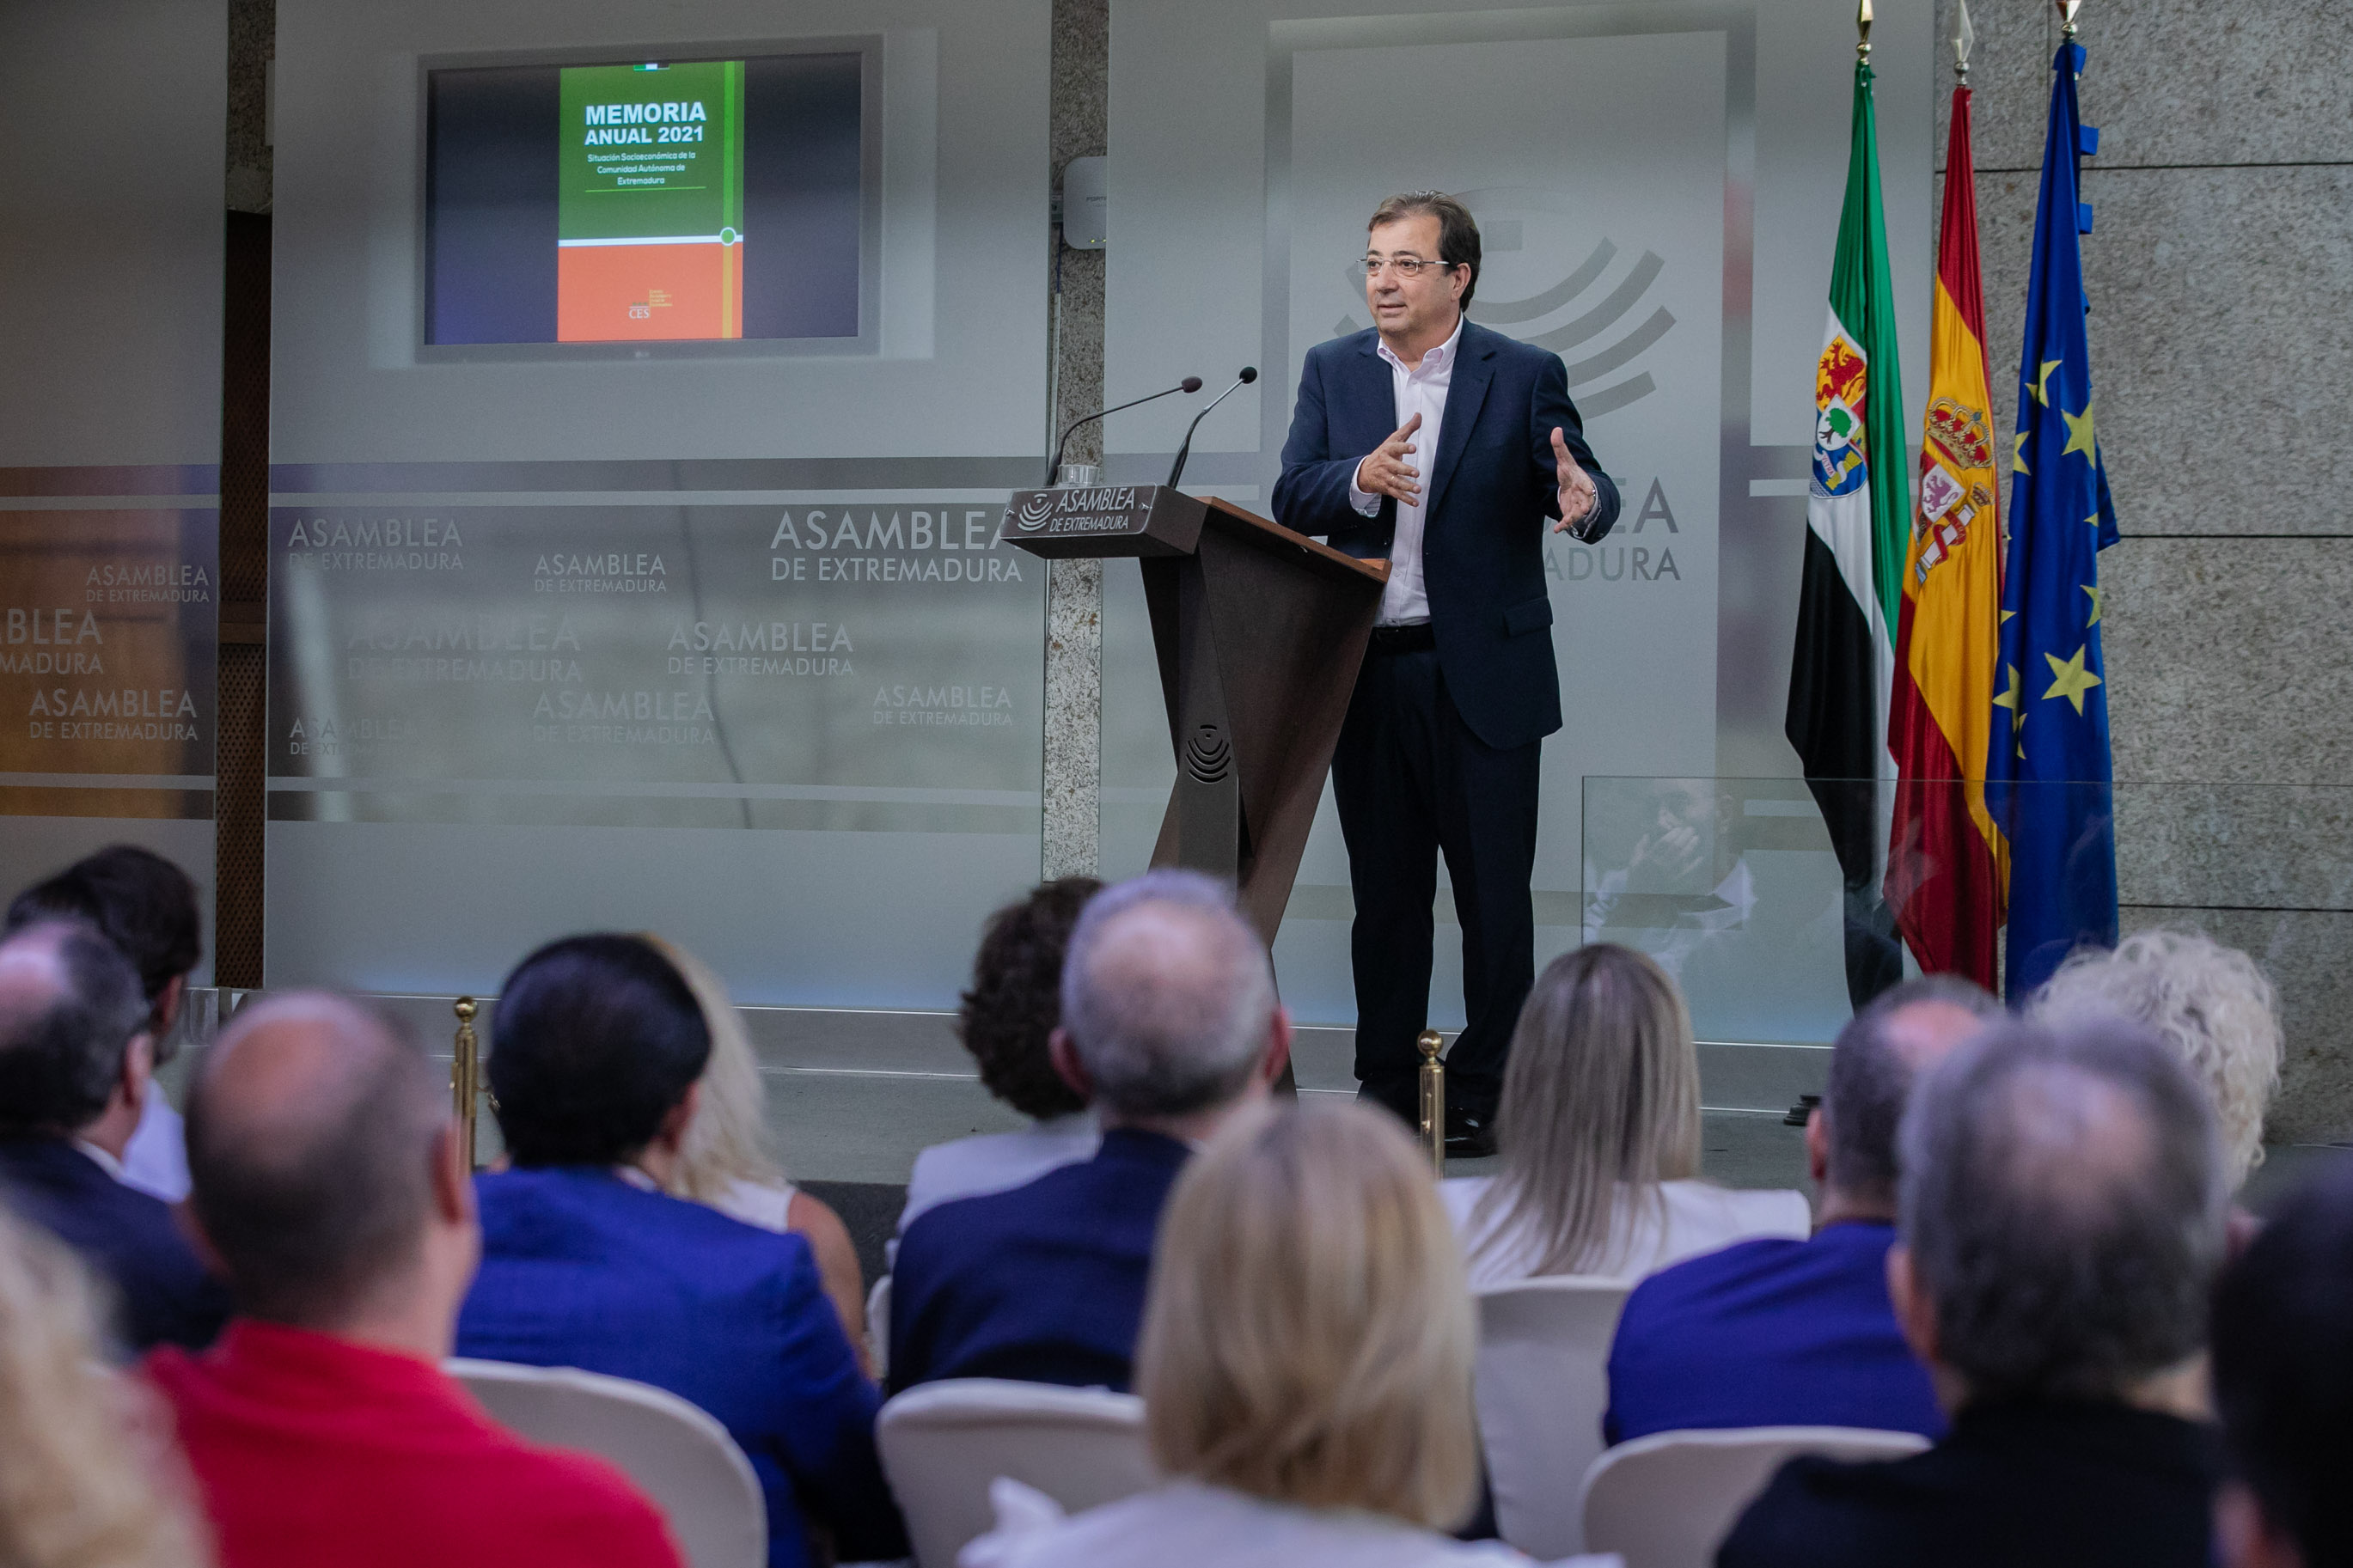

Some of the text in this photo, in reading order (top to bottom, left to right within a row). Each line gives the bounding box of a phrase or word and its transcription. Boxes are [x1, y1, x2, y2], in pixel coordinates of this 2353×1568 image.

[585, 101, 706, 125] MEMORIA
[584, 125, 703, 145] ANUAL 2021
[587, 154, 620, 162] Situación
[621, 152, 677, 162] Socioeconómica
[597, 166, 638, 174] Comunidad
[639, 164, 675, 173] Autónoma
[617, 177, 665, 186] Extremadura
[628, 308, 650, 319] CES
[1055, 487, 1134, 513] ASAMBLEA
[288, 518, 463, 547] ASAMBLEA
[770, 509, 1020, 551] ASAMBLE
[1049, 516, 1128, 532] DE EXTREMADURA
[322, 552, 464, 570] EXTREMADURA
[535, 553, 666, 576] ASAMBLEA
[772, 557, 1023, 583] DE EXTREMADURA
[86, 564, 210, 586] ASAMBLEA
[535, 579, 667, 592] DE EXTREMADURA
[87, 589, 210, 603] DE EXTREMADURA
[0, 608, 103, 644] BLEA
[667, 621, 854, 652] ASAMBLEA
[668, 657, 854, 677] DE EXTREMADURA
[28, 688, 198, 718] ASAMBLEA
[533, 690, 715, 722] ASAMBLEA
[872, 686, 1012, 709] ASAMBLEA
[872, 711, 1012, 726] DE EXTREMADURA
[30, 722, 199, 741] DE EXTREMADURA
[533, 725, 715, 745] DE EXTREMADURA
[290, 742, 309, 755] DE
